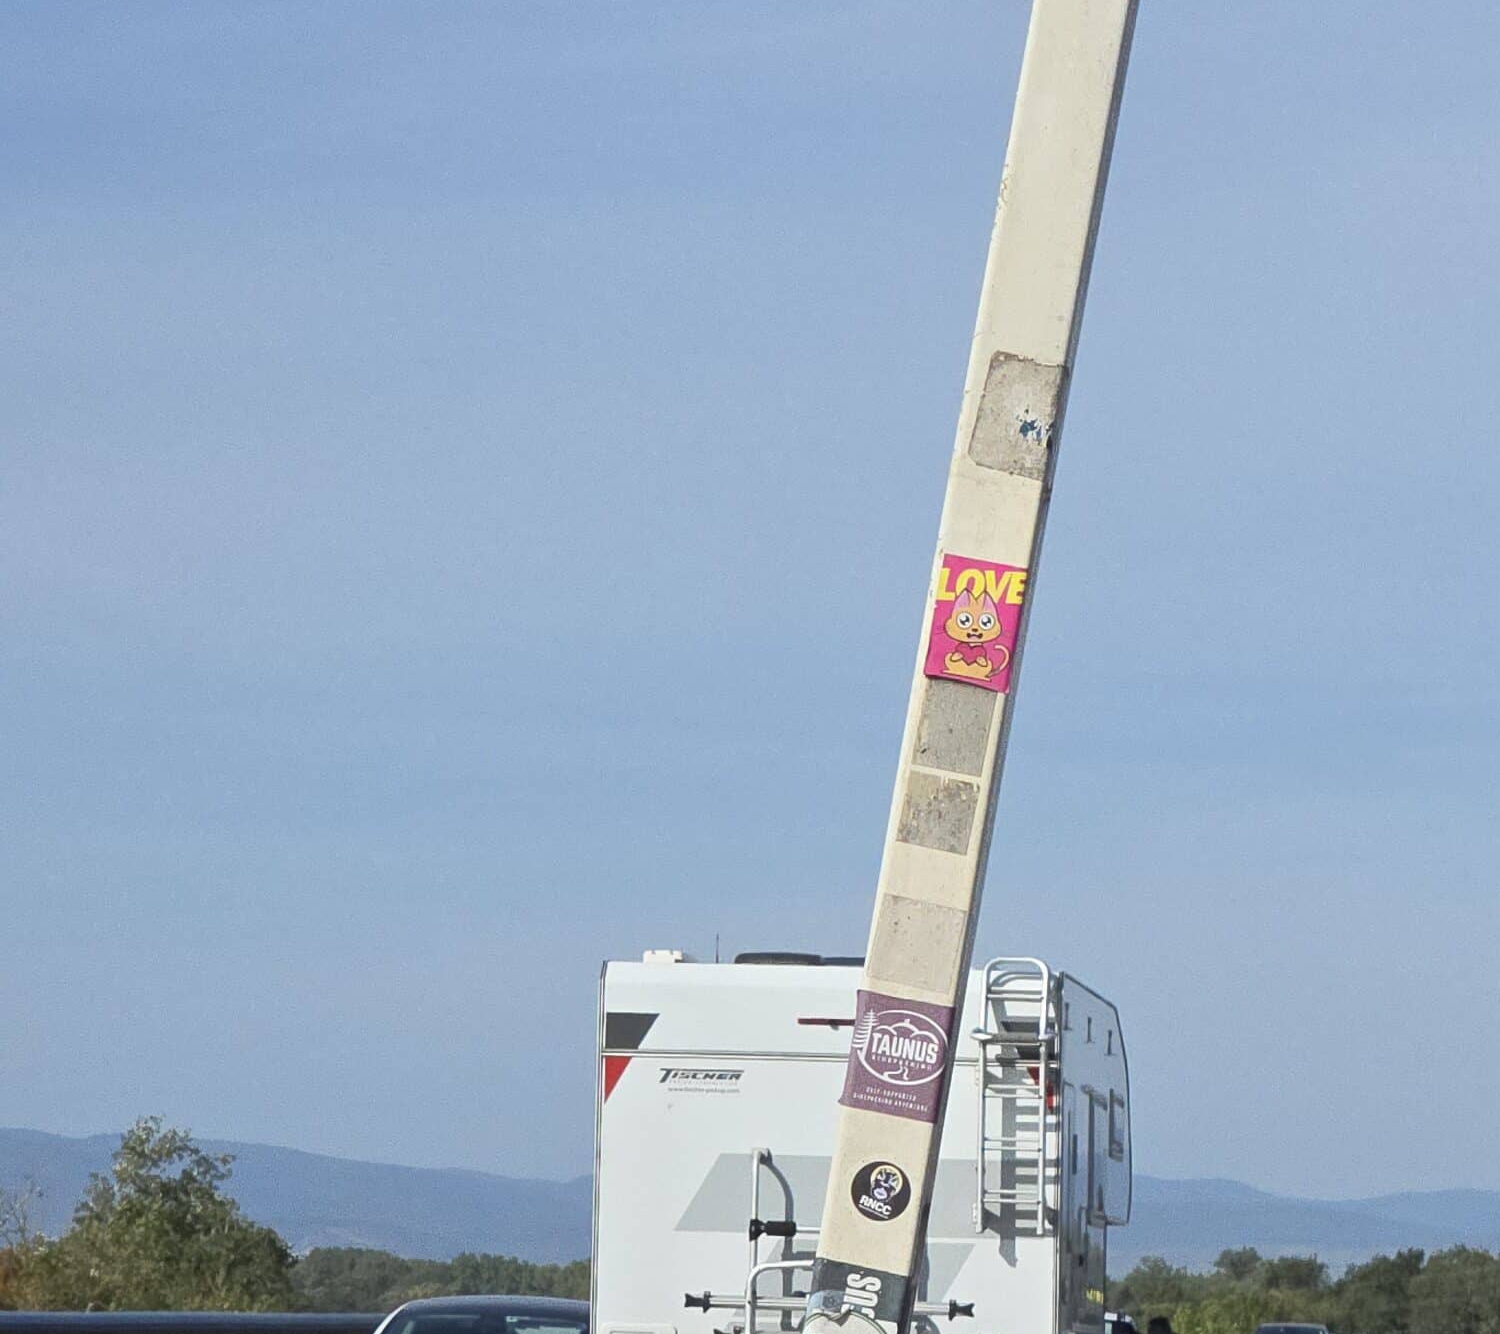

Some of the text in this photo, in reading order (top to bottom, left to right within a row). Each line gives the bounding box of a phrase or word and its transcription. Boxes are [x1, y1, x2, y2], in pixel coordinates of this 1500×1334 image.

[936, 567, 1027, 605] LOVE
[872, 1032, 939, 1064] TAUNUS
[859, 1194, 892, 1215] RNCC
